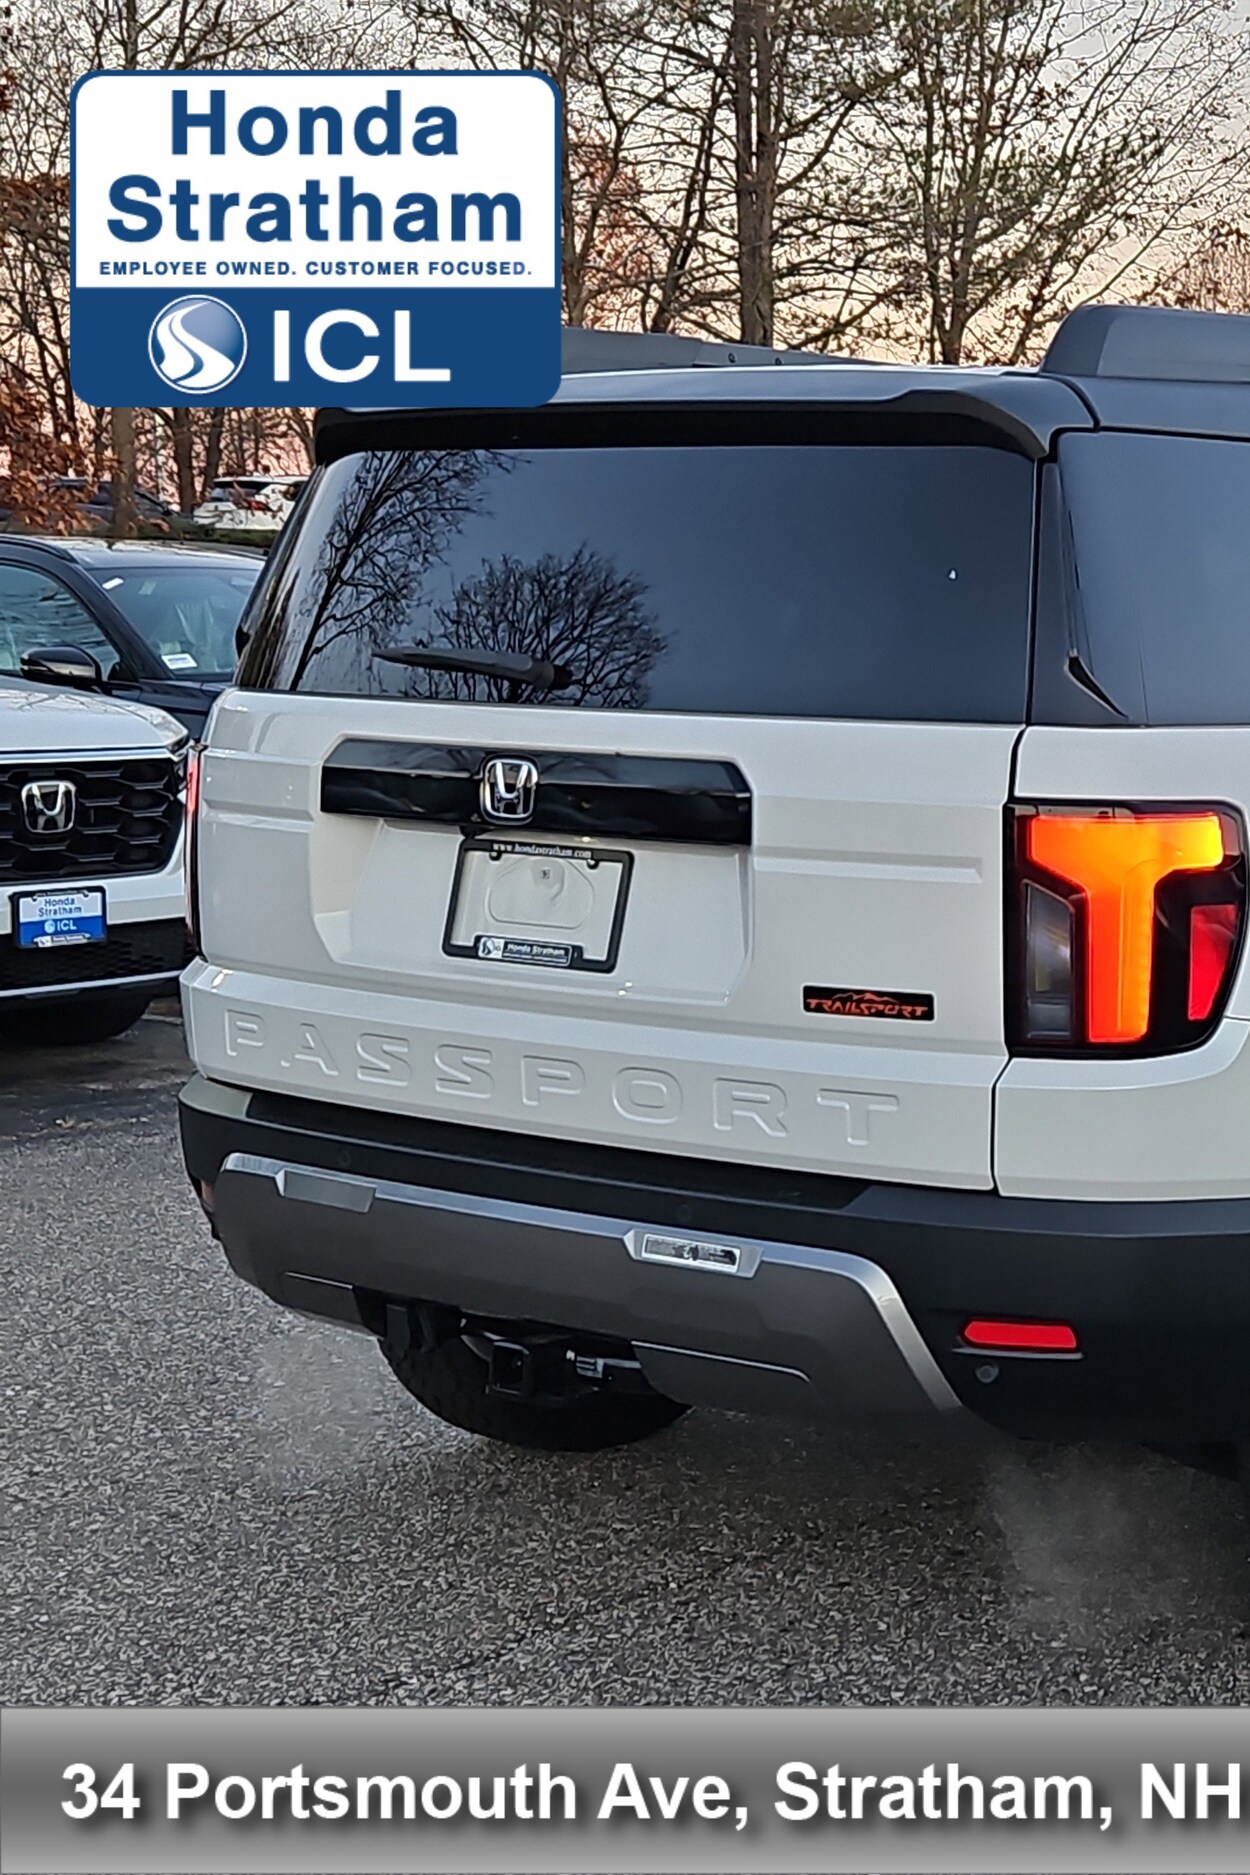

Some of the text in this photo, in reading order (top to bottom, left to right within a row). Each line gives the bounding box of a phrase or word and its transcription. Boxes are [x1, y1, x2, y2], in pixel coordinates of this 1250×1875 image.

[44, 897, 75, 907] Honda
[38, 906, 82, 917] Stratham
[56, 919, 78, 931] ICL
[507, 943, 531, 953] Honda
[806, 998, 928, 1018] TRAILSPORT
[224, 1009, 899, 1146] PASSPORT
